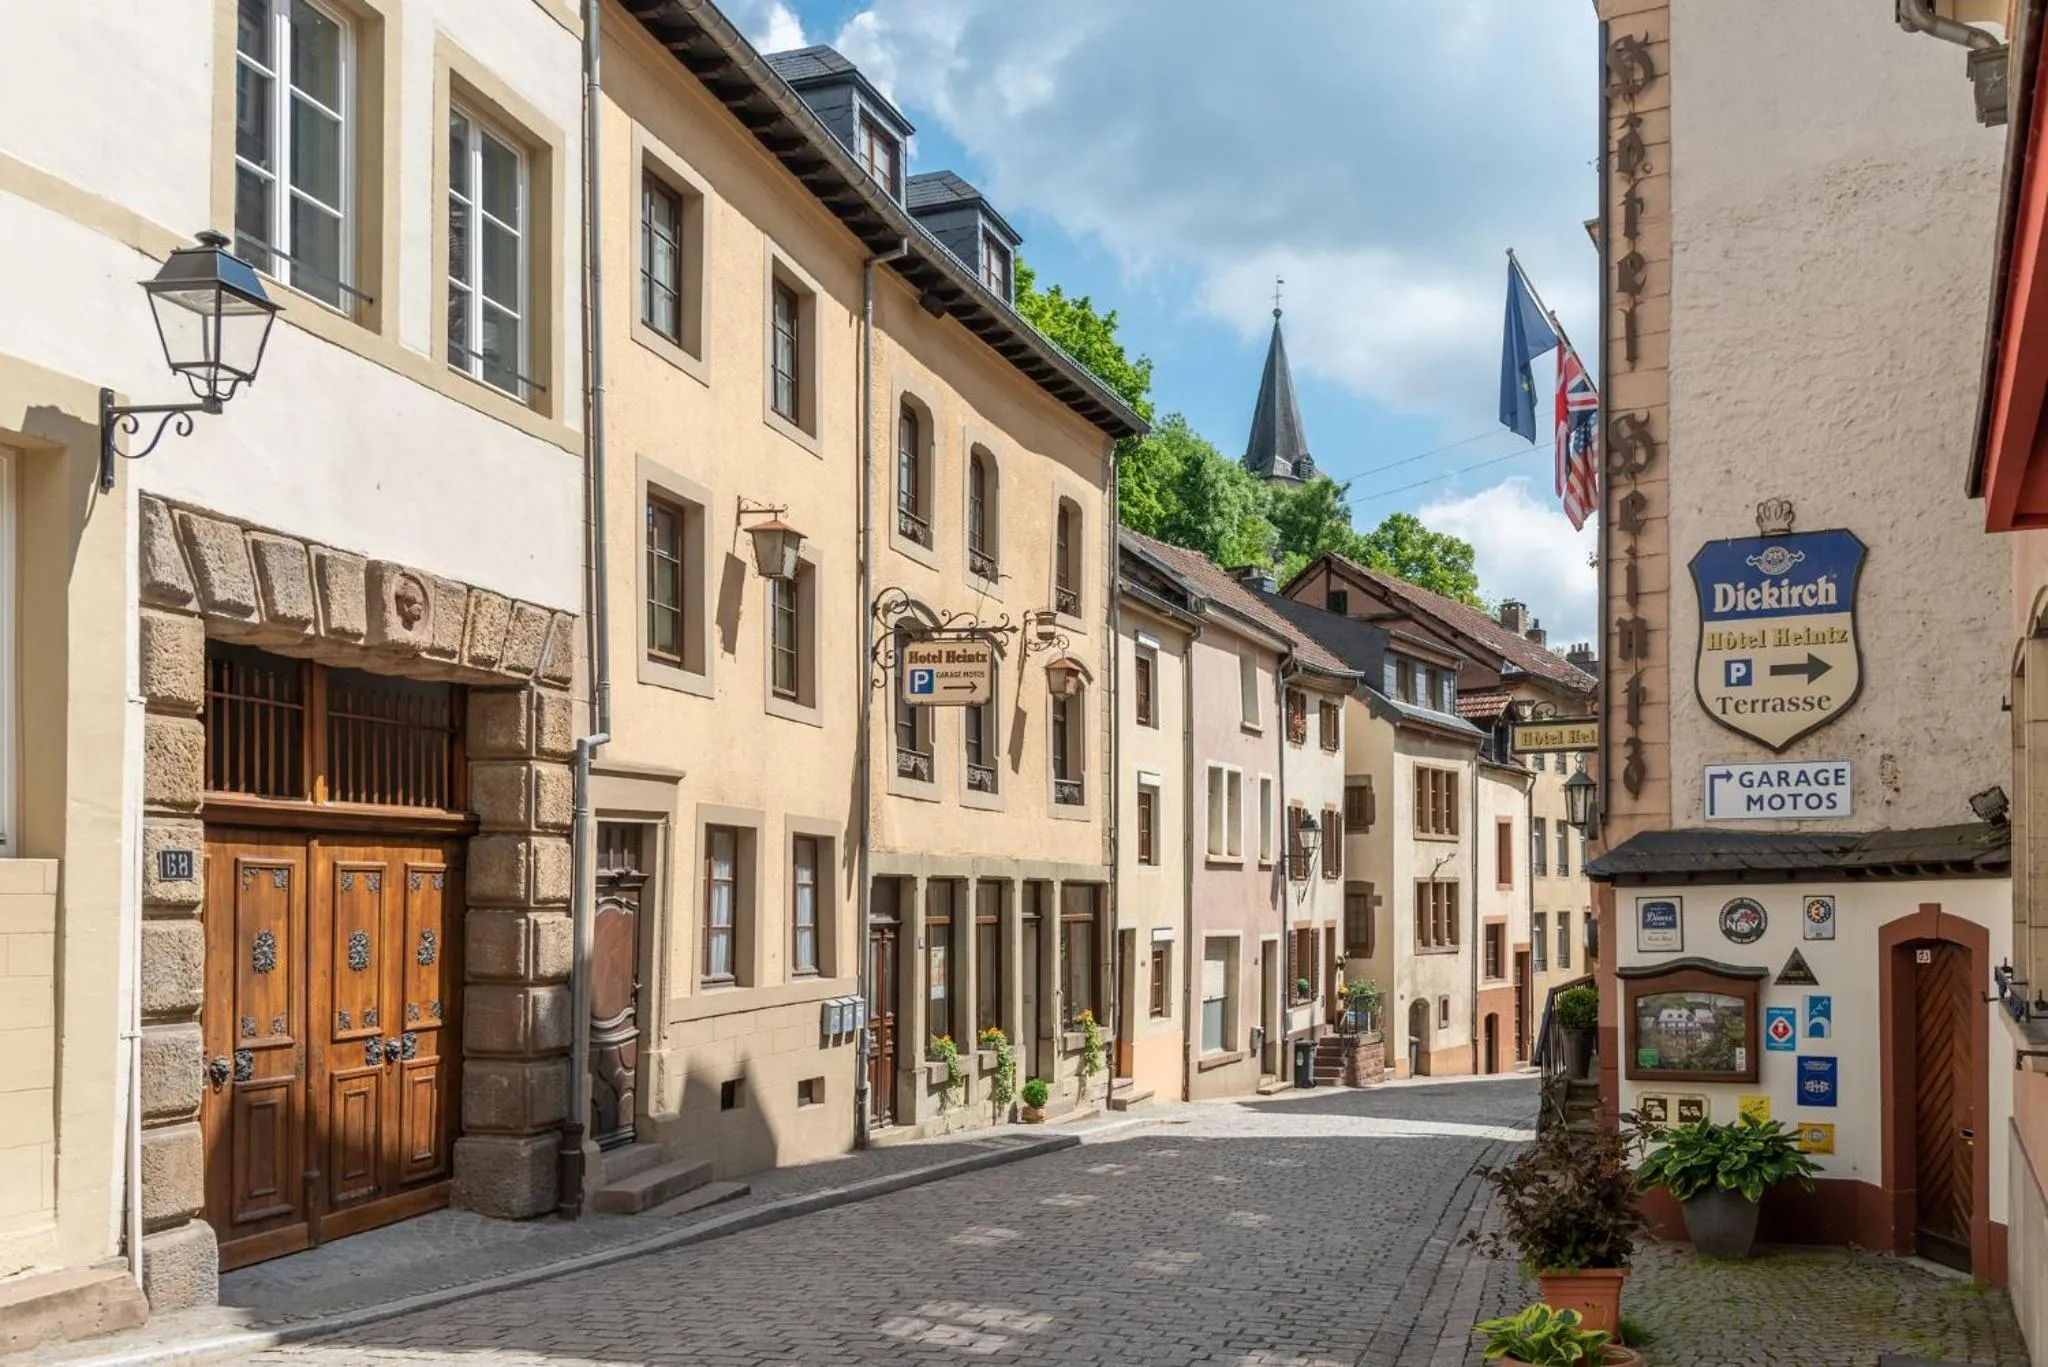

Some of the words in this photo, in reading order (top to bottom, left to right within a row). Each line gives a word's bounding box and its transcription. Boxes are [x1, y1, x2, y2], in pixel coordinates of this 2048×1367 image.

[1713, 577, 1839, 613] Diekirch
[1705, 627, 1767, 652] Hôtel
[1772, 623, 1849, 648] Heintz
[908, 650, 943, 664] Hotel
[945, 648, 988, 664] Heintz
[913, 671, 929, 693] P
[936, 671, 962, 679] GARAGE
[962, 669, 985, 679] MOTOS
[1730, 661, 1746, 684] P
[1715, 693, 1832, 715] Terrasse
[1737, 768, 1847, 789] GARAGE
[1746, 792, 1839, 813] MOTOS
[166, 852, 189, 877] 68
